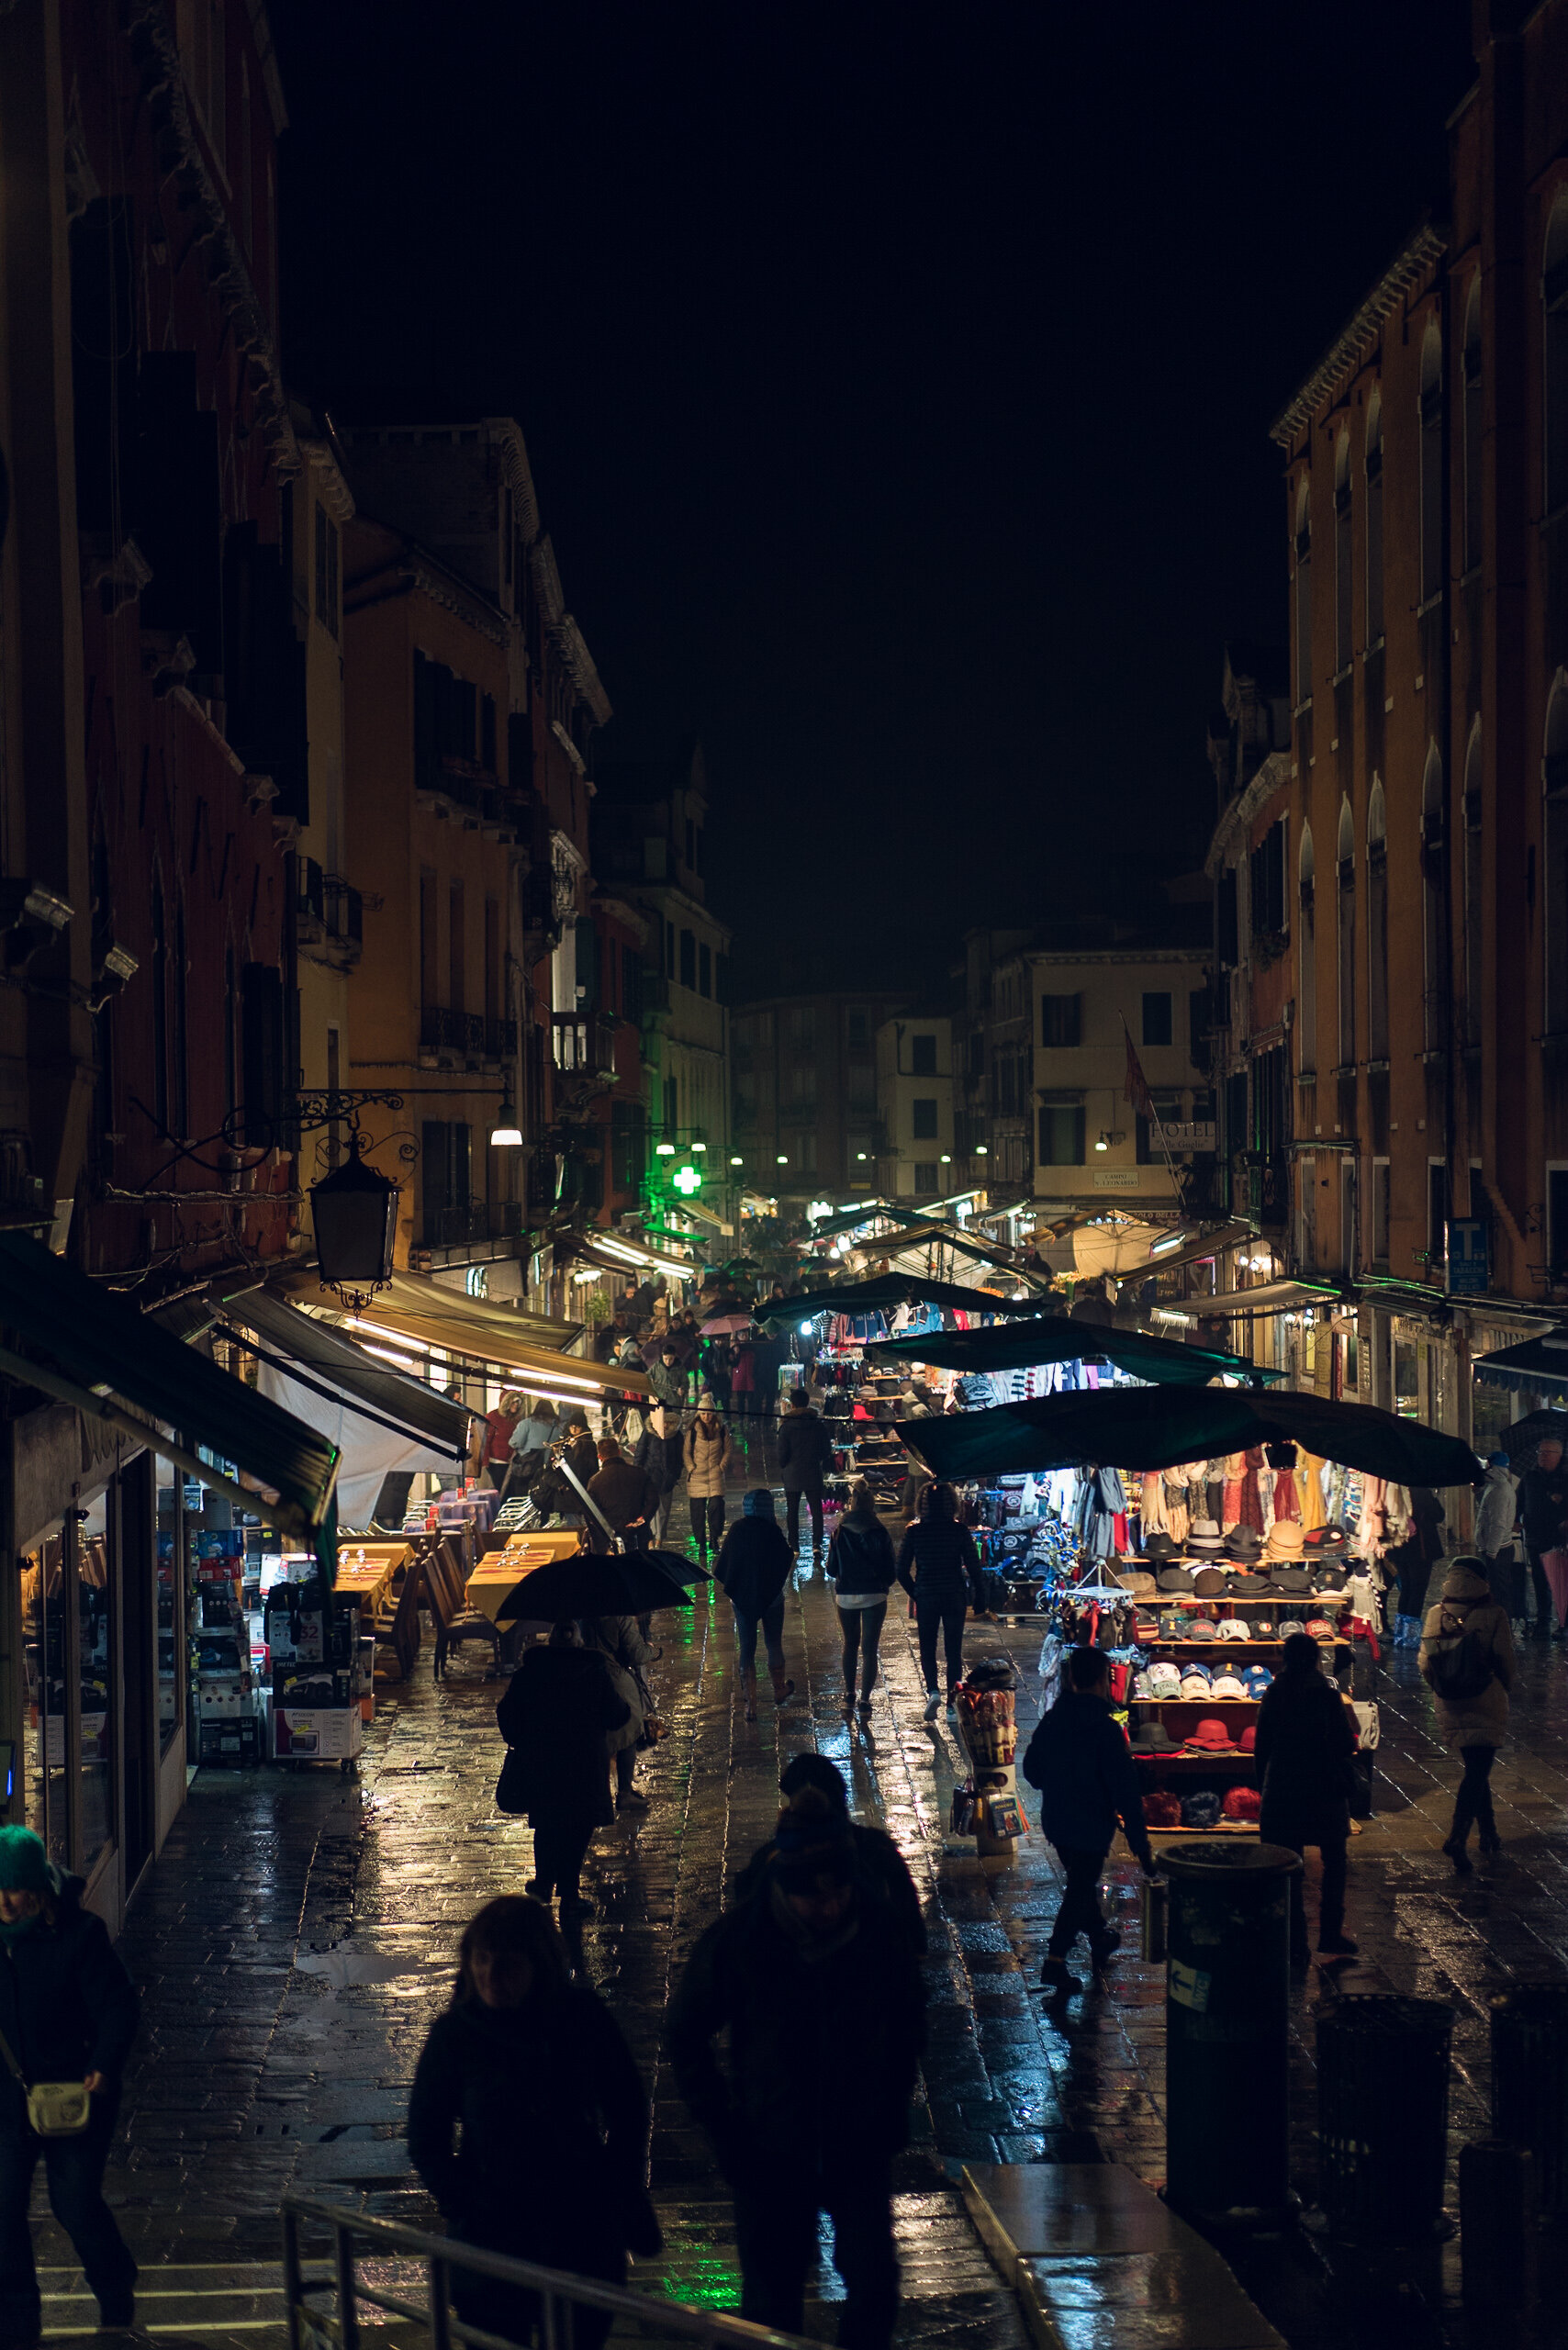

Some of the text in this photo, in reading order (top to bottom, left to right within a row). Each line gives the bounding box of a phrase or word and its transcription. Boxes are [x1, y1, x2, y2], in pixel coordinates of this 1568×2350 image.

[1151, 1123, 1214, 1137] HOTEL
[1454, 1223, 1481, 1260] T
[301, 1625, 319, 1639] 32
